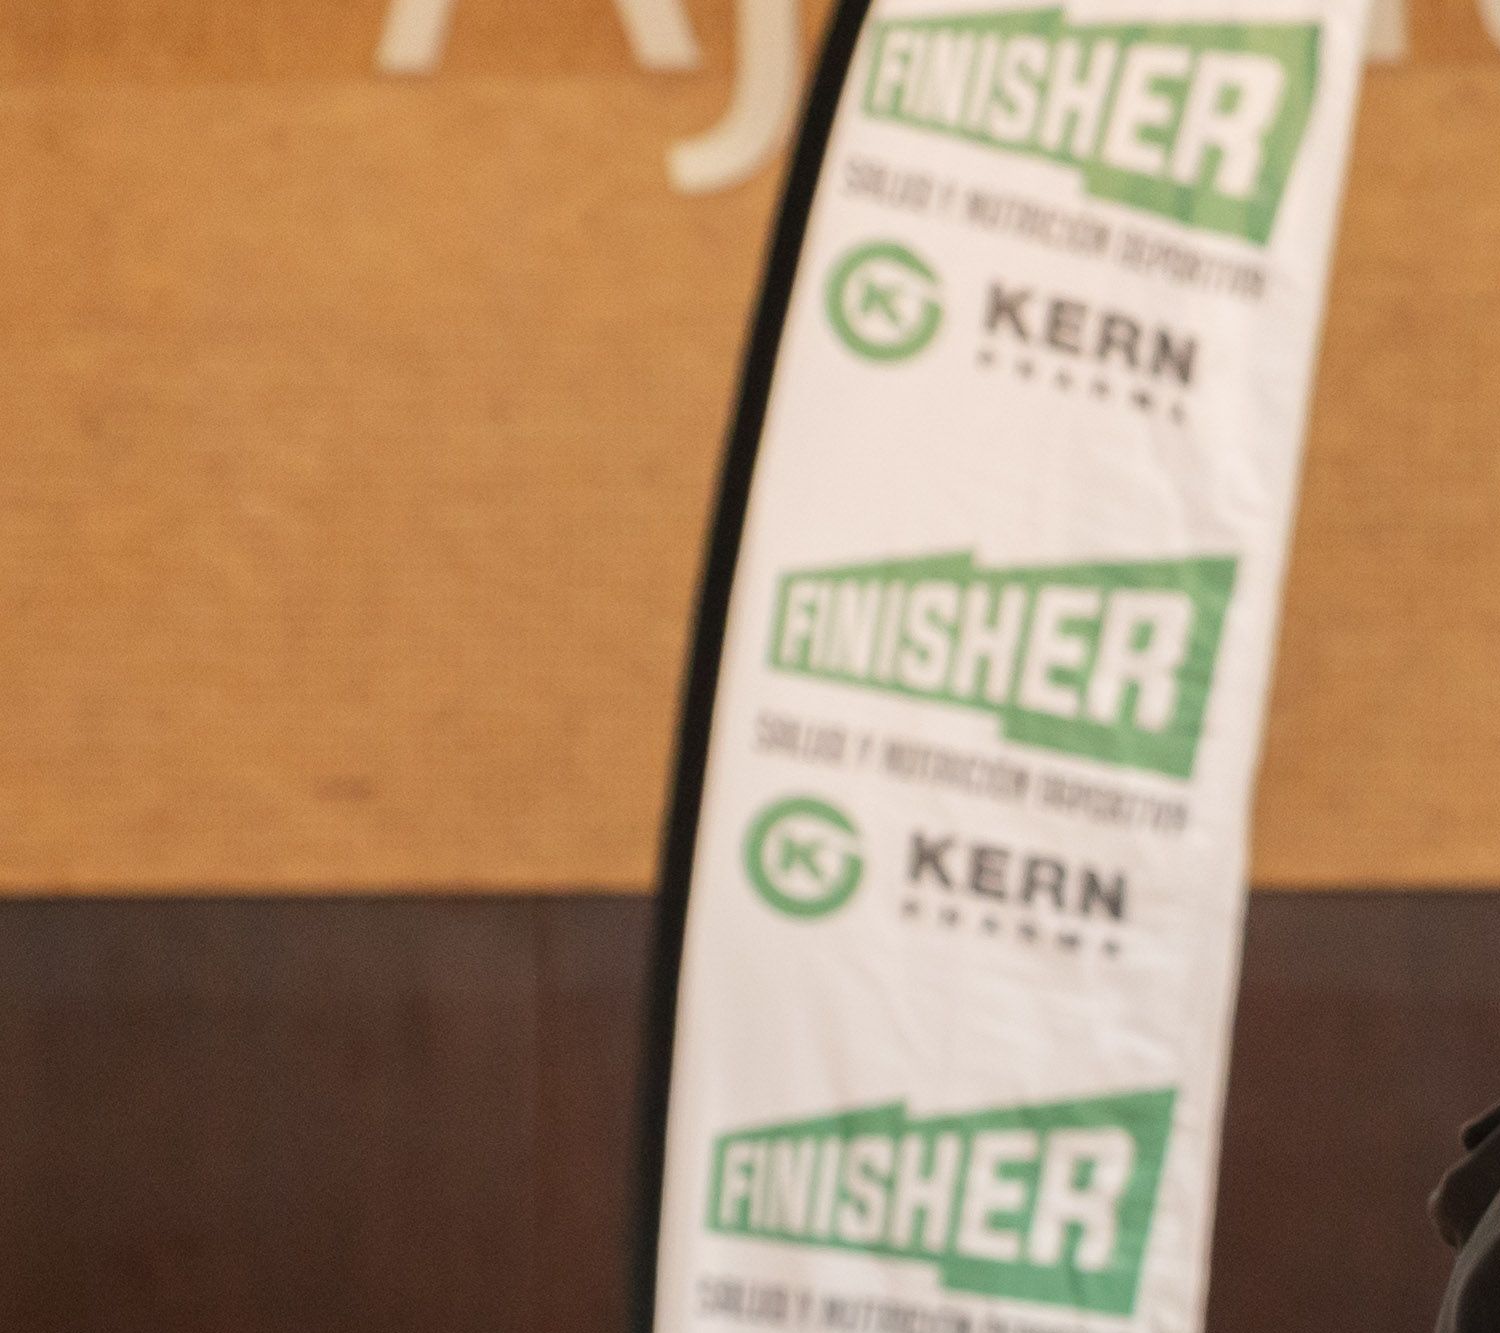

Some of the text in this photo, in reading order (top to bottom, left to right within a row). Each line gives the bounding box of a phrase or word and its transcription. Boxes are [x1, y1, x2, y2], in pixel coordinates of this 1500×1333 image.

[872, 28, 1284, 196] FINISHER
[984, 281, 1198, 386] KERN
[781, 576, 1194, 732] FINISHER
[907, 830, 1127, 922] KERN
[720, 1127, 1137, 1272] FINISHER
